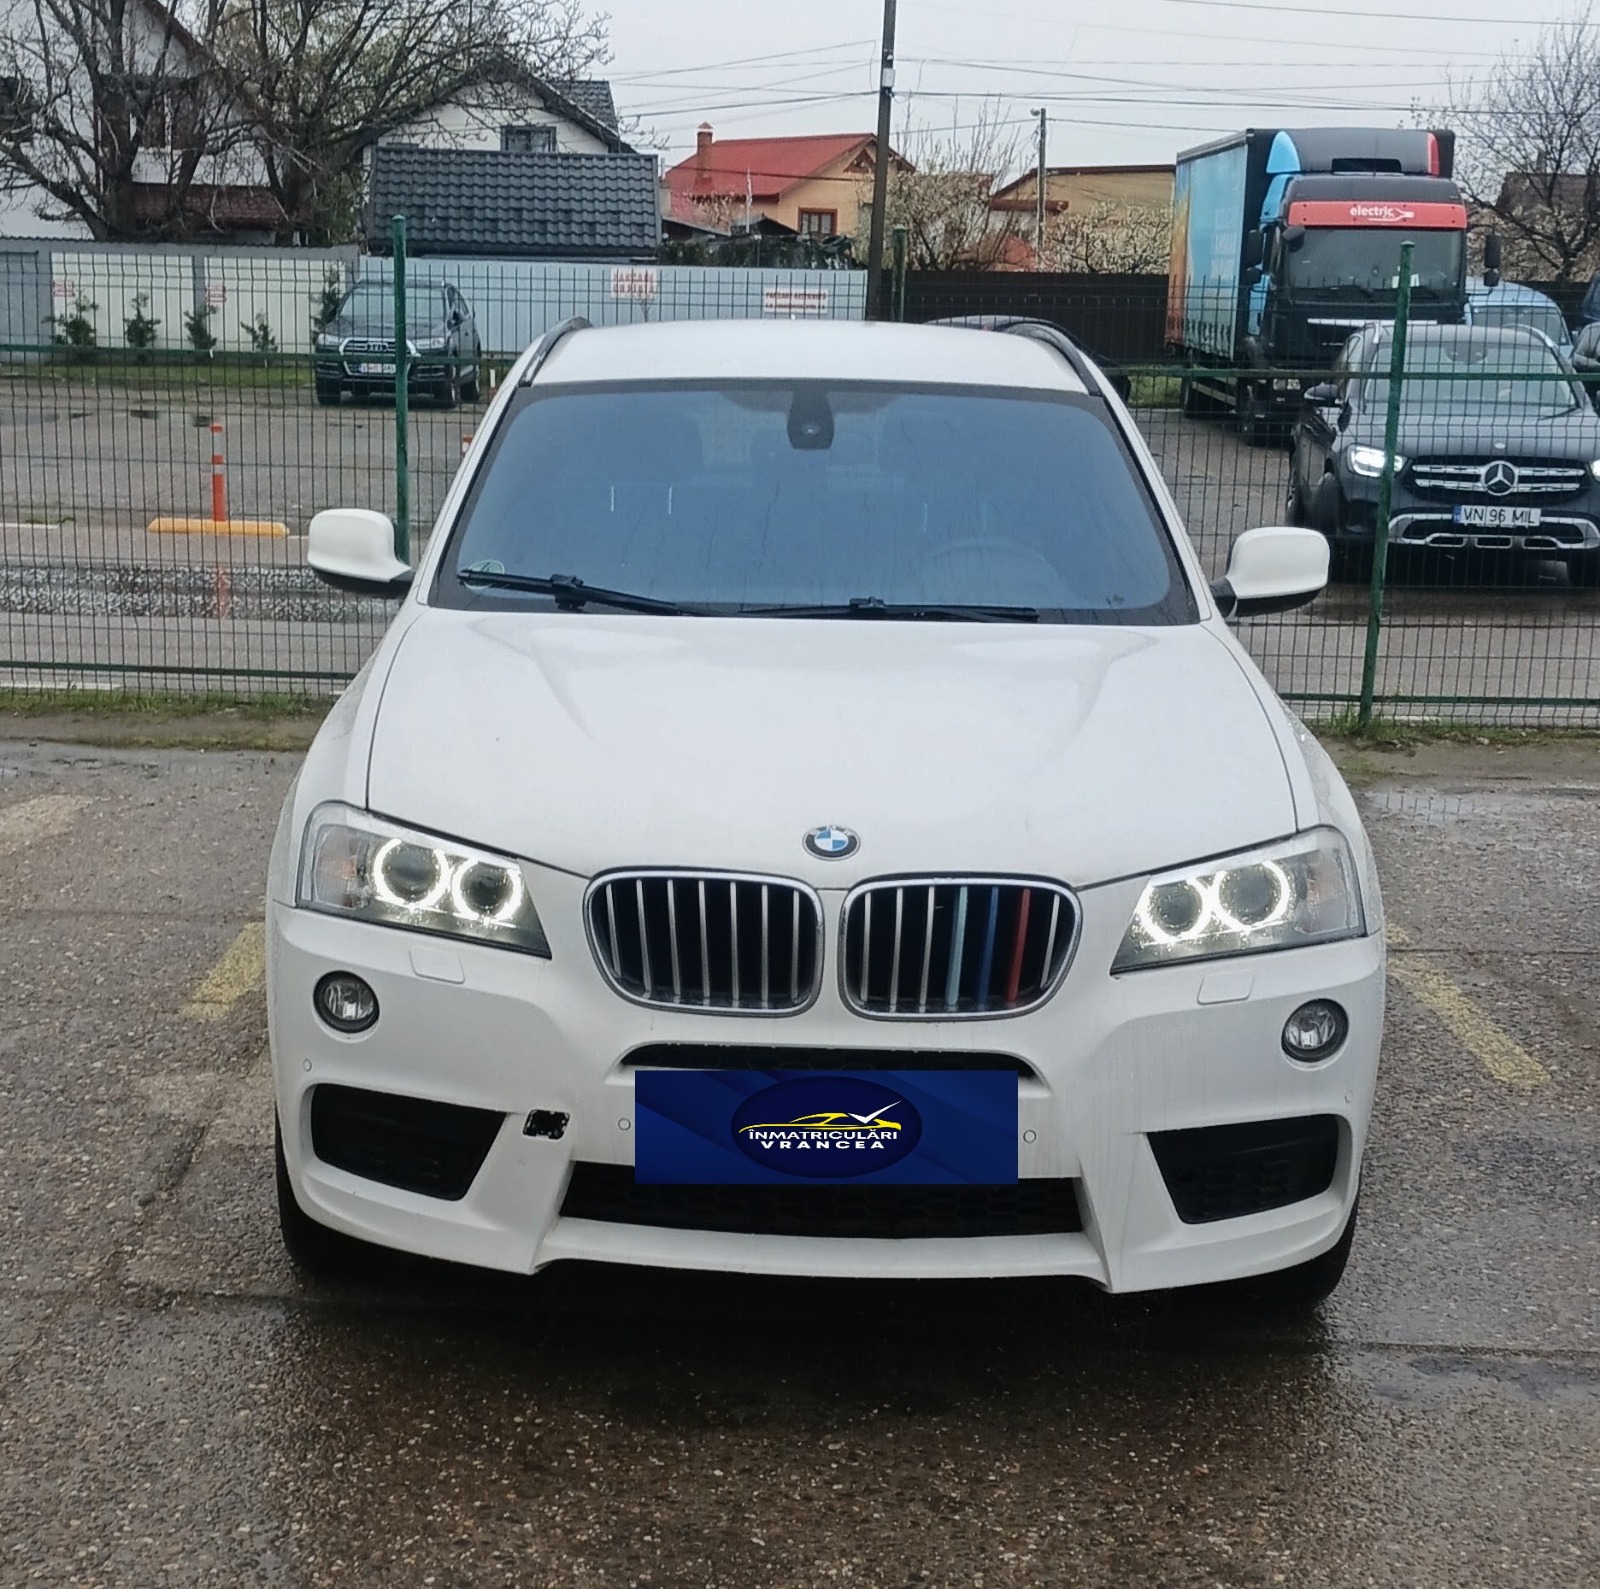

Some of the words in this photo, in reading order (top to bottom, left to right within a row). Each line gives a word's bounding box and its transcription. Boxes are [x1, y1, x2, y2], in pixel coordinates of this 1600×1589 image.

[1349, 205, 1393, 216] electric
[1463, 508, 1484, 521] VN
[1489, 509, 1506, 523] 96
